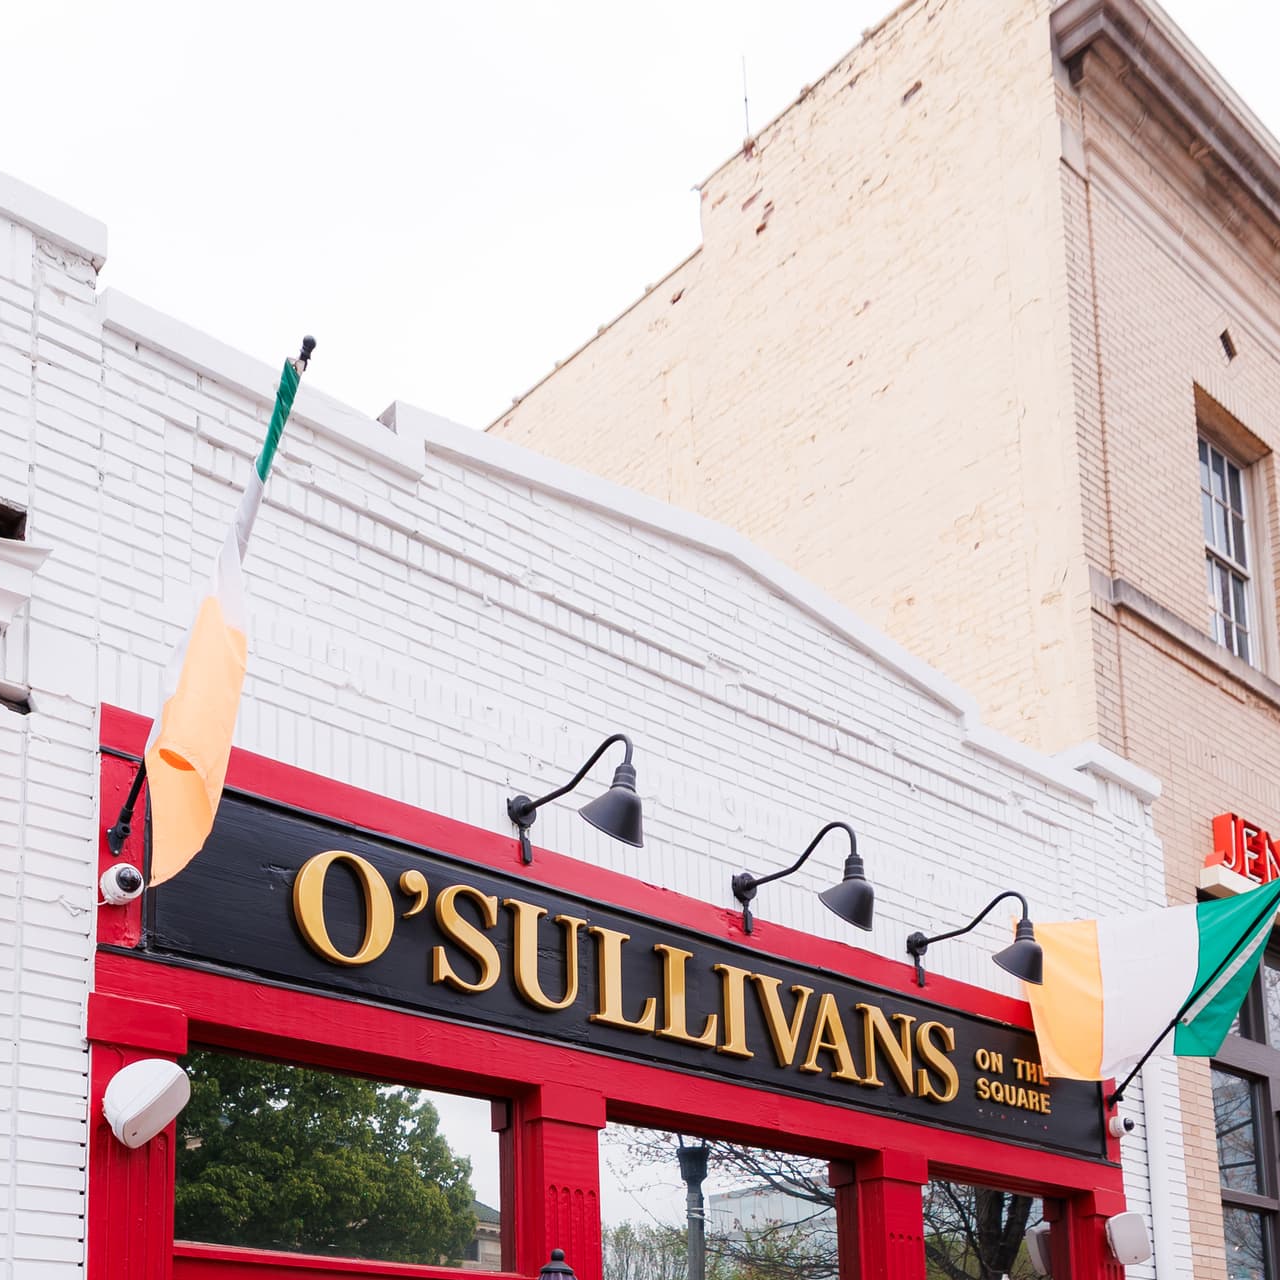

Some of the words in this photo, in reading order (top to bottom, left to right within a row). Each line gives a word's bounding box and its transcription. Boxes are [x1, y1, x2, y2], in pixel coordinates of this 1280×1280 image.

[291, 849, 960, 1104] O'SULLIVANS
[975, 1048, 1004, 1074] ON
[976, 1077, 1052, 1115] SQUARE
